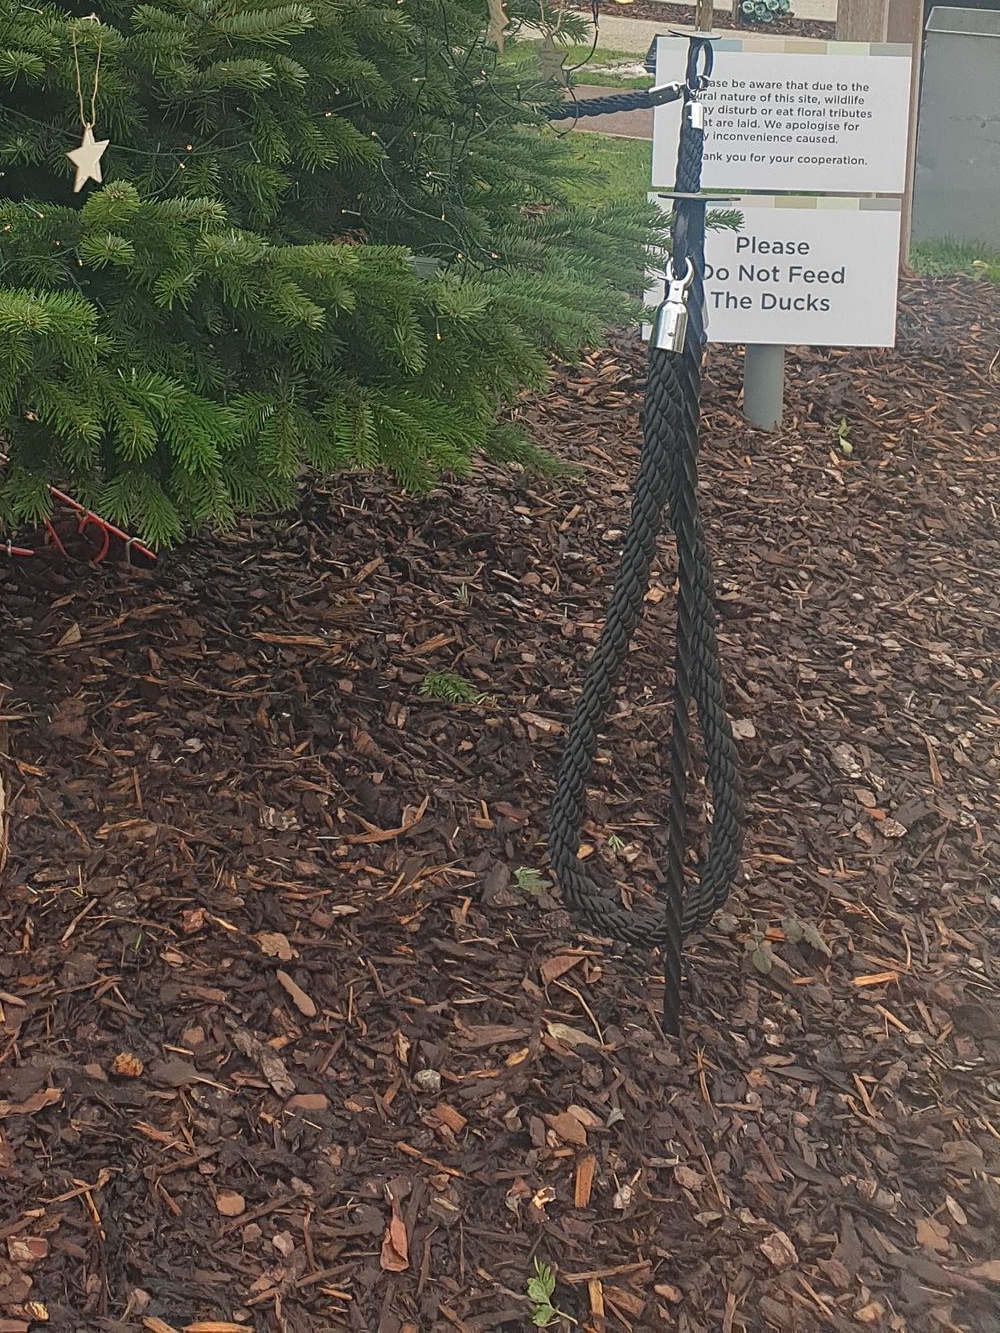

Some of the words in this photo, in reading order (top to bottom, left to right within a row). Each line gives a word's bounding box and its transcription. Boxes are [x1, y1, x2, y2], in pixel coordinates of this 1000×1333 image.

[732, 79, 746, 88] be
[749, 81, 782, 89] aware
[786, 81, 808, 90] that
[811, 81, 833, 91] due
[836, 82, 848, 91] to
[851, 82, 869, 92] the
[720, 93, 756, 102] nature
[760, 93, 772, 102] of
[775, 93, 795, 103] this
[798, 94, 821, 105] site,
[824, 95, 865, 105] wildlife
[718, 105, 757, 115] disturb
[776, 108, 794, 116] eat
[797, 107, 826, 117] floral
[829, 108, 873, 118] tributes
[716, 120, 734, 128] are
[737, 119, 760, 128] laid.
[764, 120, 782, 129] We
[785, 121, 840, 132] apologise
[843, 122, 859, 131] for
[713, 131, 793, 143] inconvenience
[796, 134, 838, 144] caused.
[726, 154, 746, 162] you
[750, 153, 766, 162] for
[769, 156, 794, 164] your
[797, 155, 868, 165] cooperation.
[736, 236, 810, 255] Please
[703, 263, 730, 281] Do
[738, 264, 780, 282] Not
[789, 266, 846, 284] Feed
[711, 291, 753, 309] The
[761, 293, 831, 311] Ducks
